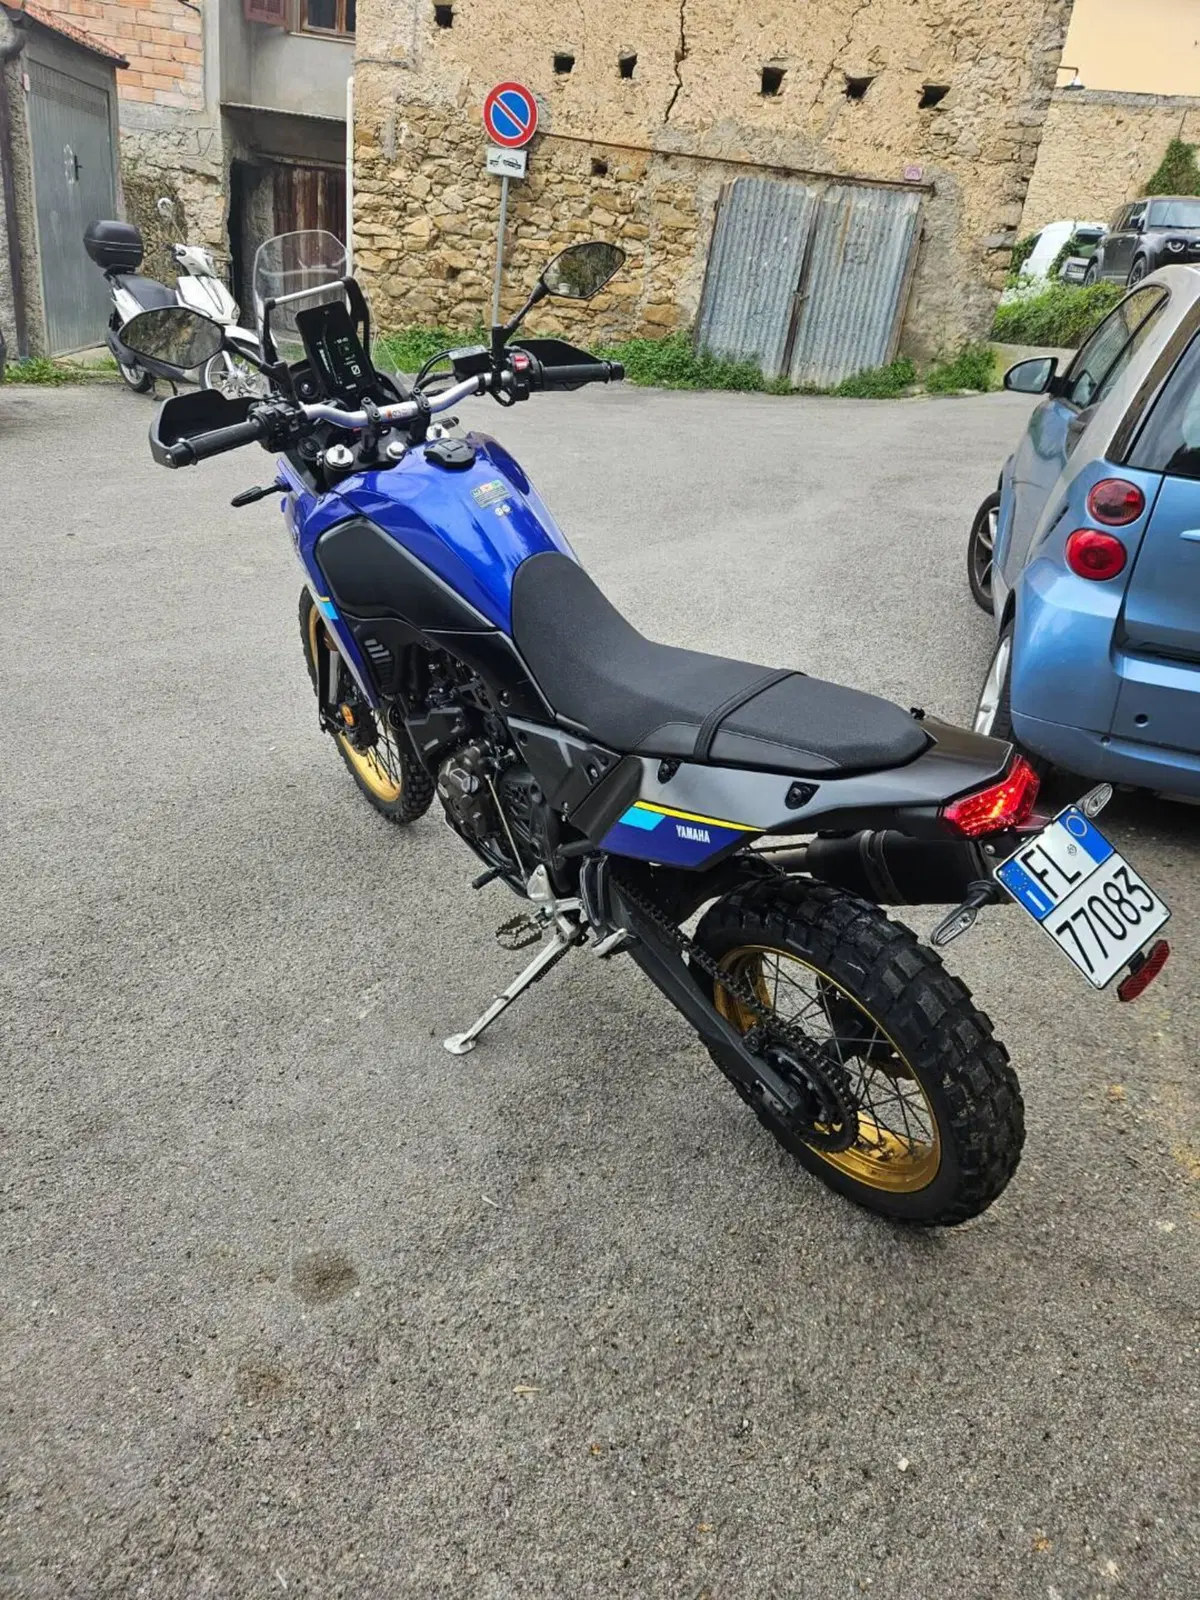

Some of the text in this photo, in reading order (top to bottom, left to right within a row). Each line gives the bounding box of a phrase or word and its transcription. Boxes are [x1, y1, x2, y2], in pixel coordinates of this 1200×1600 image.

[676, 824, 710, 844] YAMAHA
[1020, 844, 1082, 899] FL
[1055, 865, 1154, 974] 77083
